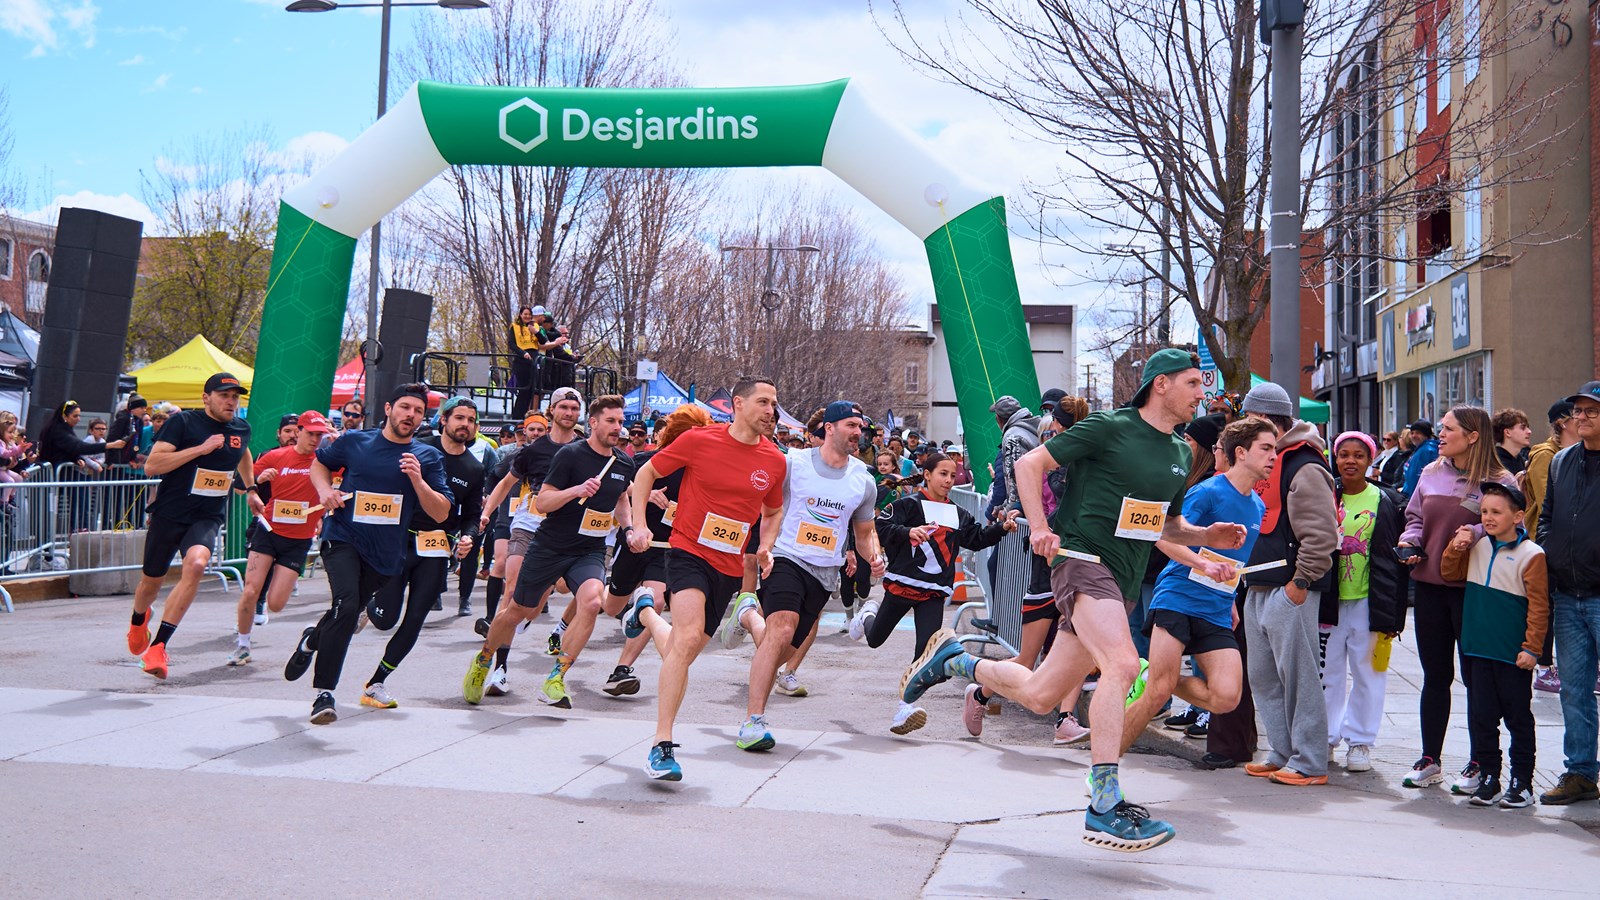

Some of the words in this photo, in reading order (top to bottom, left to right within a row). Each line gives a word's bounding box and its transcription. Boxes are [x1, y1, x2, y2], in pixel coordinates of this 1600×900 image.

[562, 106, 759, 150] Desjardins
[204, 477, 226, 487] 78-01
[451, 477, 469, 488] DOYLE
[364, 502, 392, 513] 39-01
[815, 497, 846, 511] Joliette
[280, 508, 302, 516] 46-01
[1129, 512, 1161, 526] 120-01
[712, 526, 740, 541] 32-01
[806, 532, 831, 545] 95-01
